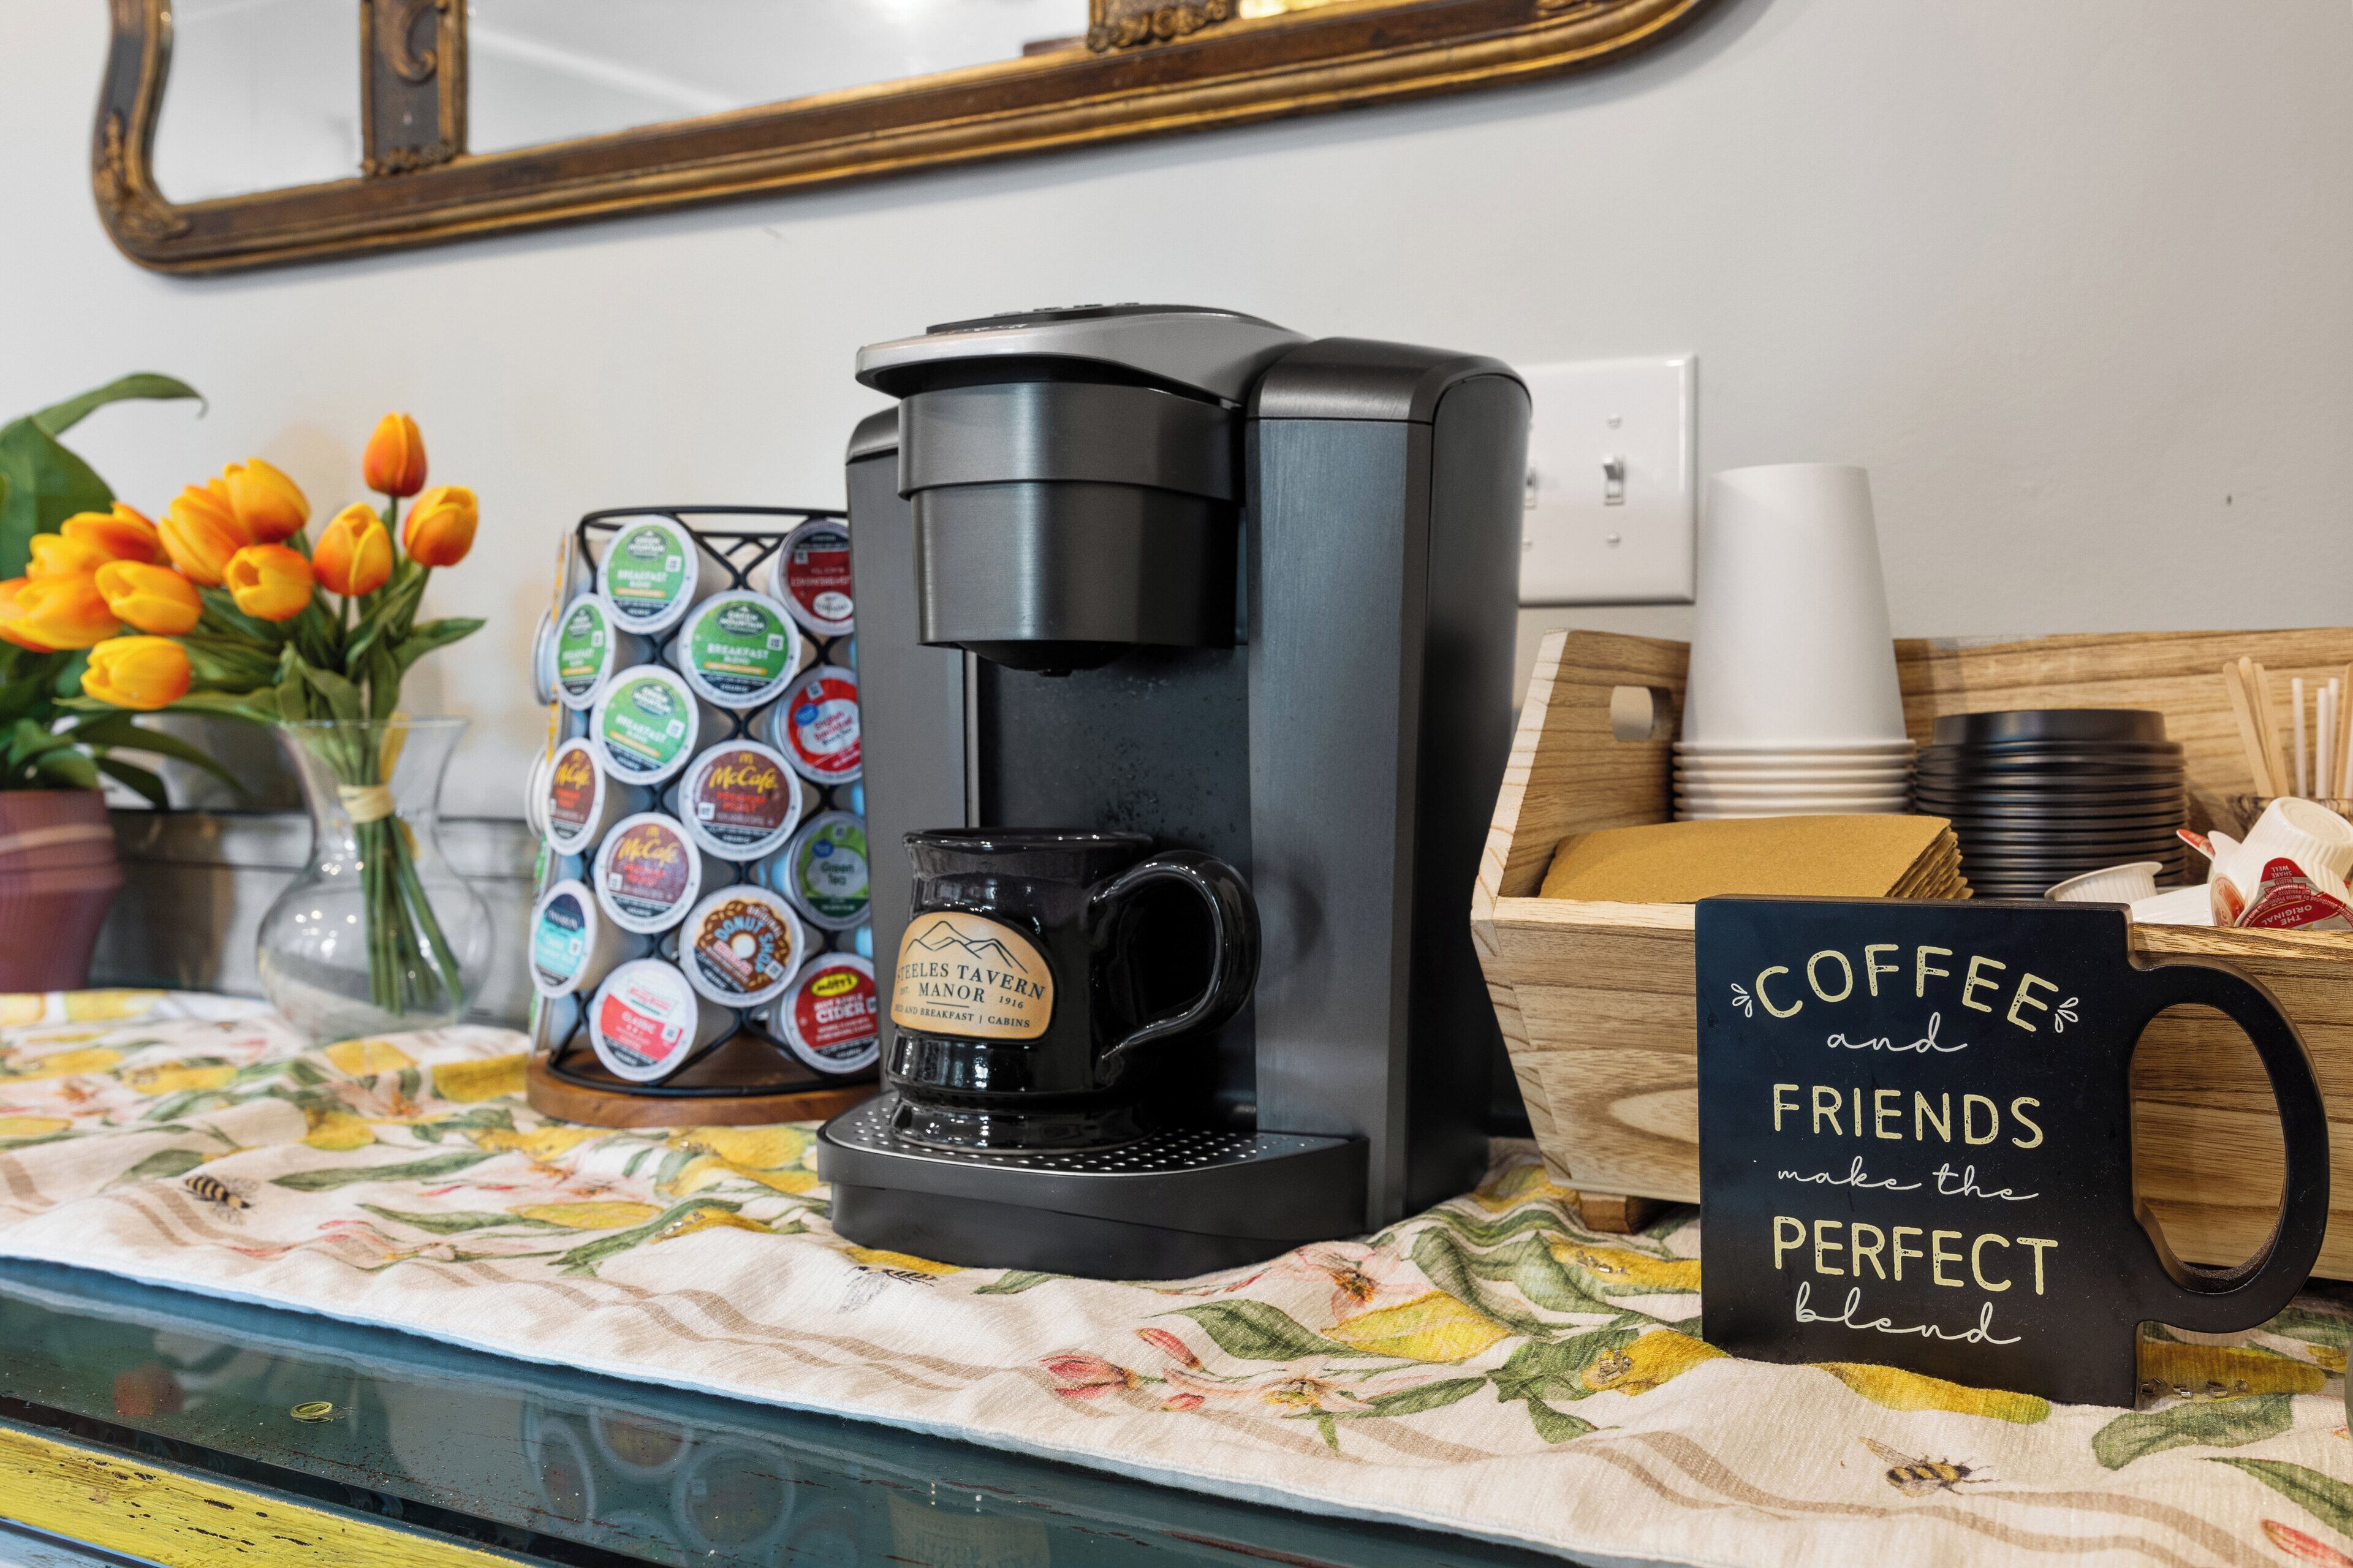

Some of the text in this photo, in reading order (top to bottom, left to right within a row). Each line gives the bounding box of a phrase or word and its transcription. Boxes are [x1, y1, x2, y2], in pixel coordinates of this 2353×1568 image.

[707, 643, 768, 659] BREAKFAST
[820, 862, 854, 873] Green
[828, 874, 846, 885] Tea
[2261, 904, 2313, 925] ORIGINAL
[2311, 896, 2338, 909] Distributed
[714, 915, 765, 941] DONUT
[746, 904, 784, 939] ORIGINAL
[2280, 915, 2302, 926] THE
[919, 982, 985, 1003] MANOR
[999, 996, 1024, 1009] 1916
[957, 964, 1046, 1001] TAVERN
[1756, 944, 2058, 1032] COFFEE
[815, 1002, 866, 1025] CIDER
[905, 1006, 918, 1015] AND
[920, 1008, 975, 1021] BREAKFAST
[988, 1016, 1030, 1028] CABINS
[1827, 1012, 1967, 1053] and
[1774, 1084, 2043, 1148] FRIENDS
[1778, 1156, 2039, 1200] make the
[1774, 1216, 2058, 1295] PERFECT
[1796, 1282, 2021, 1344] blend
